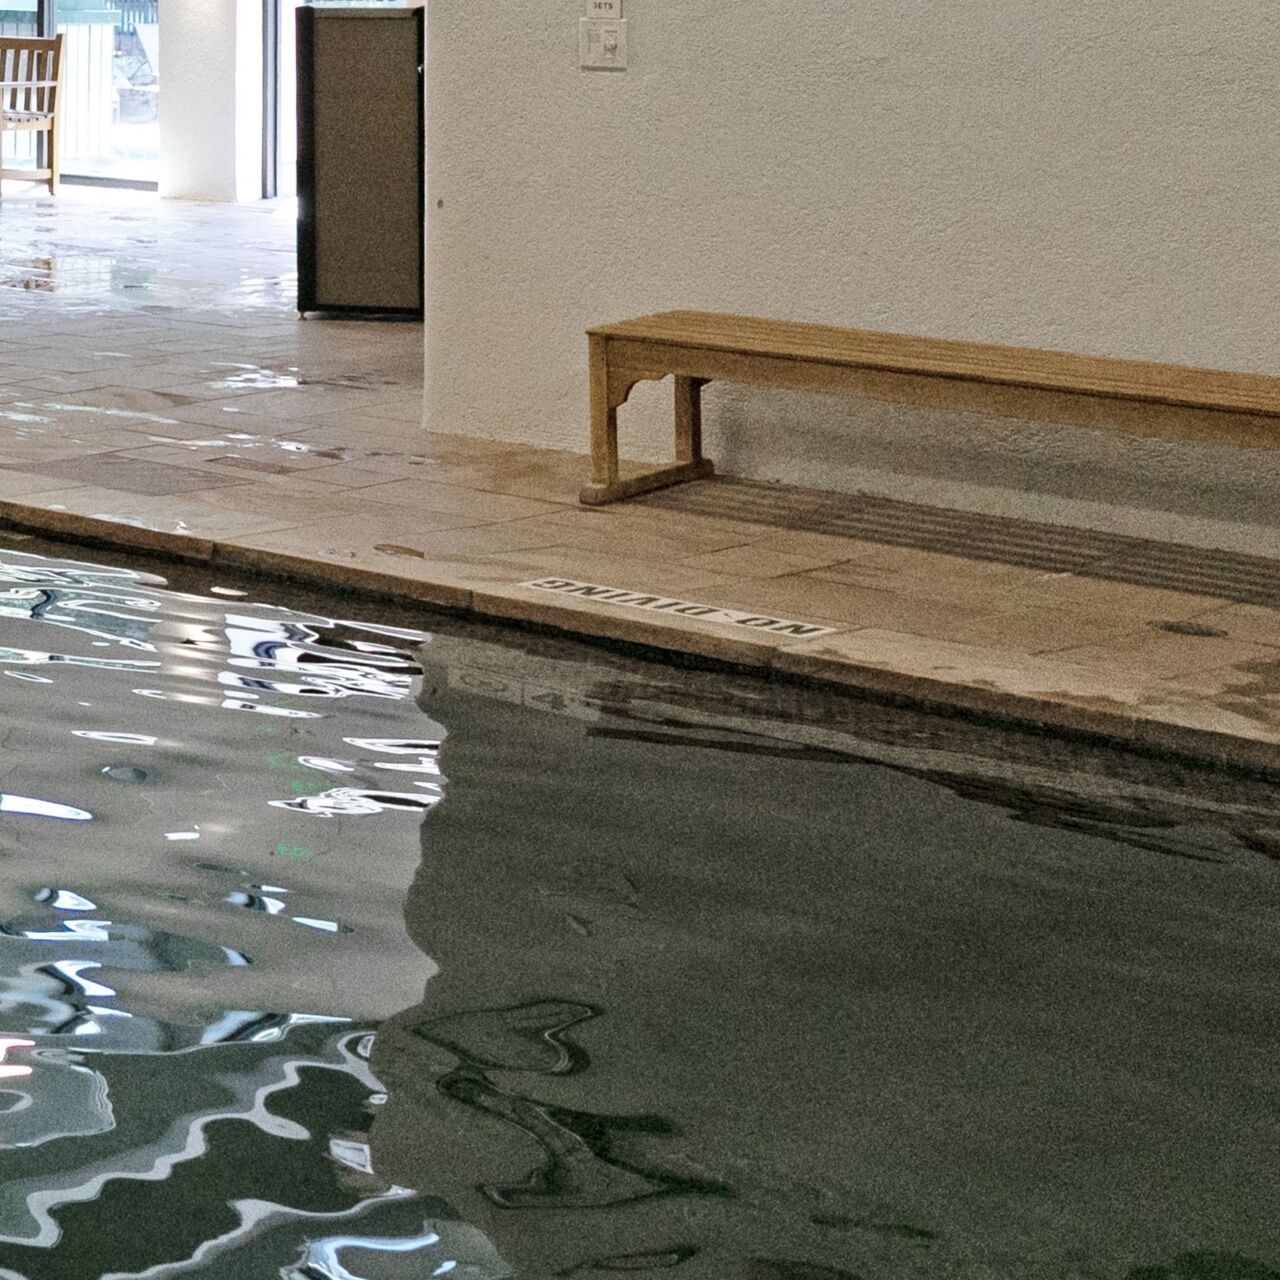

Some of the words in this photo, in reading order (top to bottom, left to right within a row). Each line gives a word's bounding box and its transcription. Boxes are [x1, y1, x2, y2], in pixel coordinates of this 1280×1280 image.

[592, 2, 614, 10] JETS
[531, 579, 720, 616] DIVING
[734, 617, 824, 636] NO
